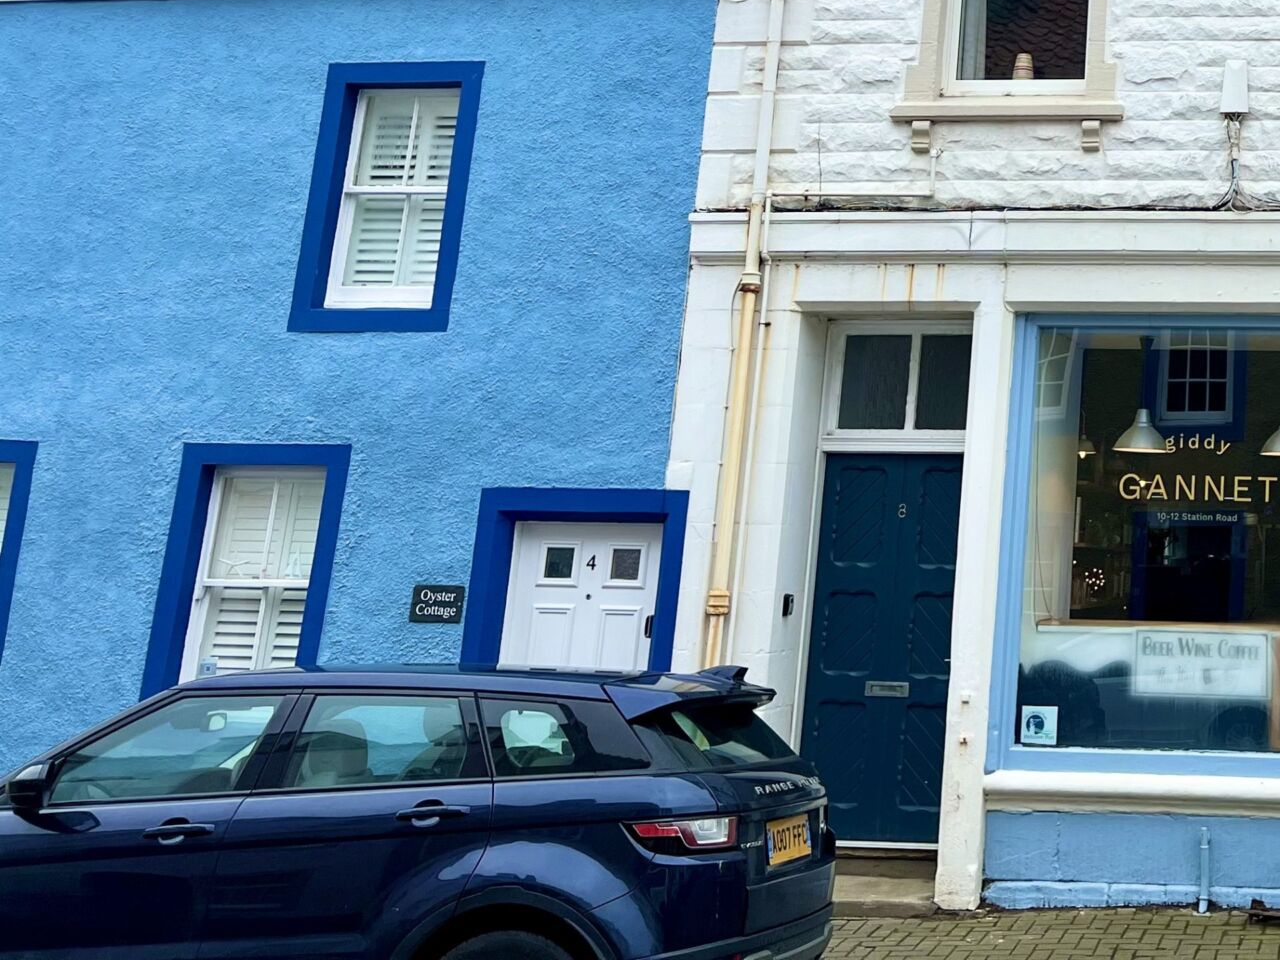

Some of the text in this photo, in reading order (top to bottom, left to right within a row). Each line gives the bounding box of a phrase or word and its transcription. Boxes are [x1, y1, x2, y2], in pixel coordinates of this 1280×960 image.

[1165, 433, 1231, 455] giddy
[1119, 473, 1278, 503] GANNET
[1157, 512, 1238, 522] 10-12 Station Road
[586, 554, 596, 571] 4
[420, 589, 456, 604] Oyster
[415, 603, 457, 618] Cottage
[754, 781, 795, 795] RANGE
